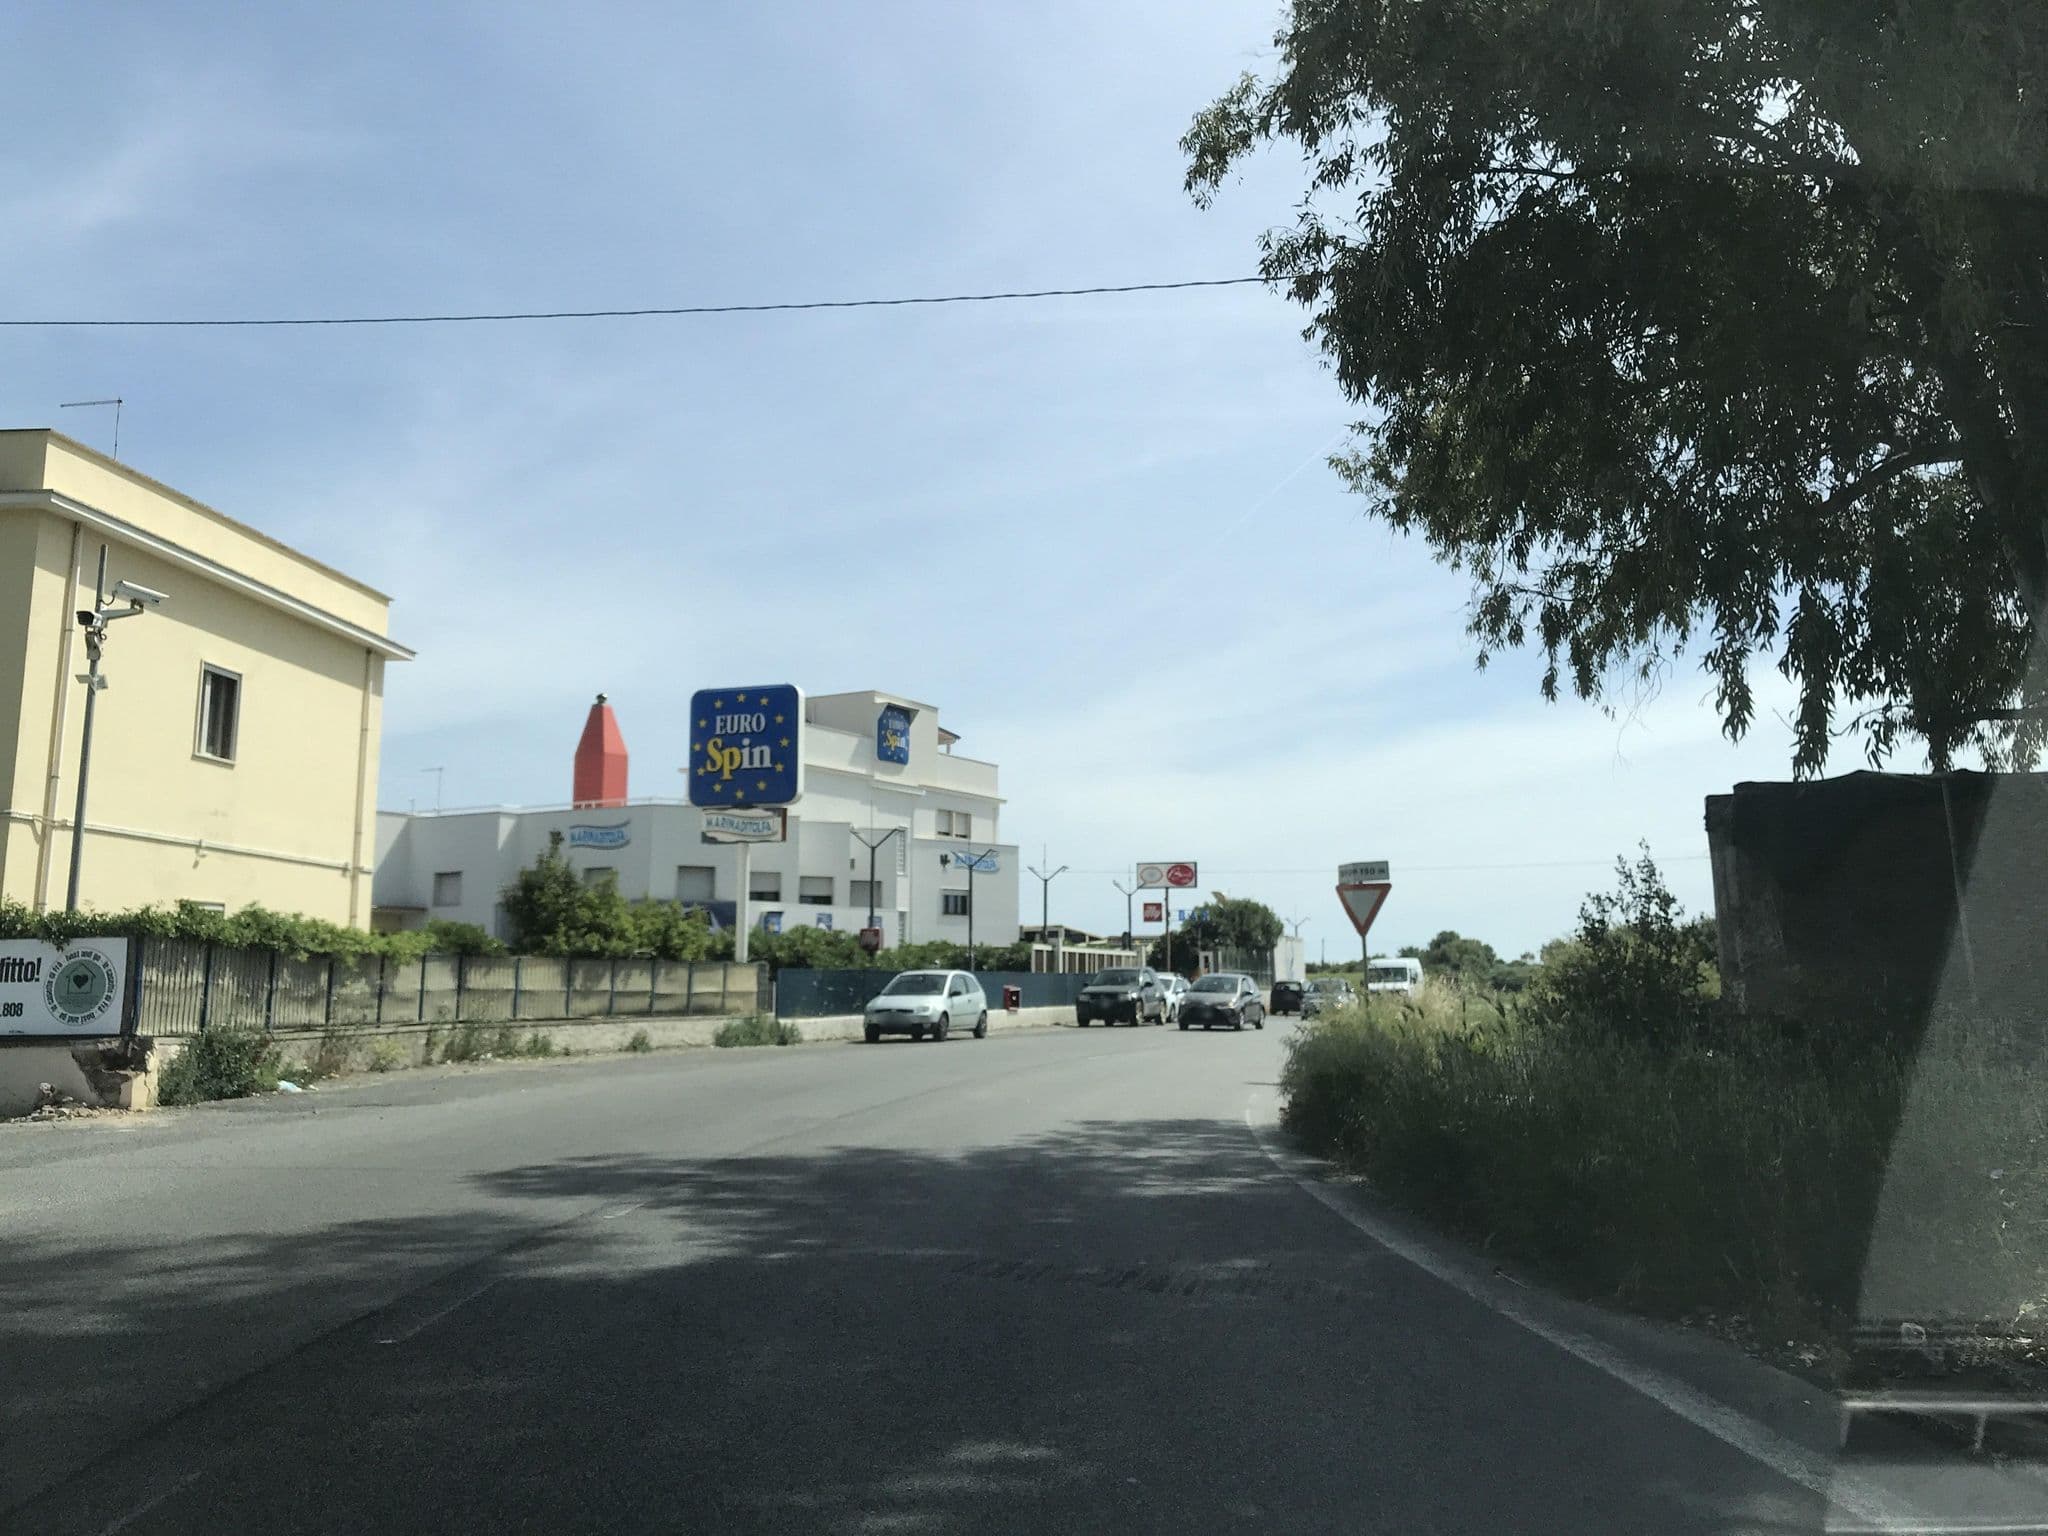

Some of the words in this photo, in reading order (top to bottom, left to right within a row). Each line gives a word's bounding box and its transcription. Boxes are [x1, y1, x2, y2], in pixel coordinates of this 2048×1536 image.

[715, 713, 765, 735] EURO
[886, 729, 906, 751] Spin
[706, 737, 773, 781] Spin
